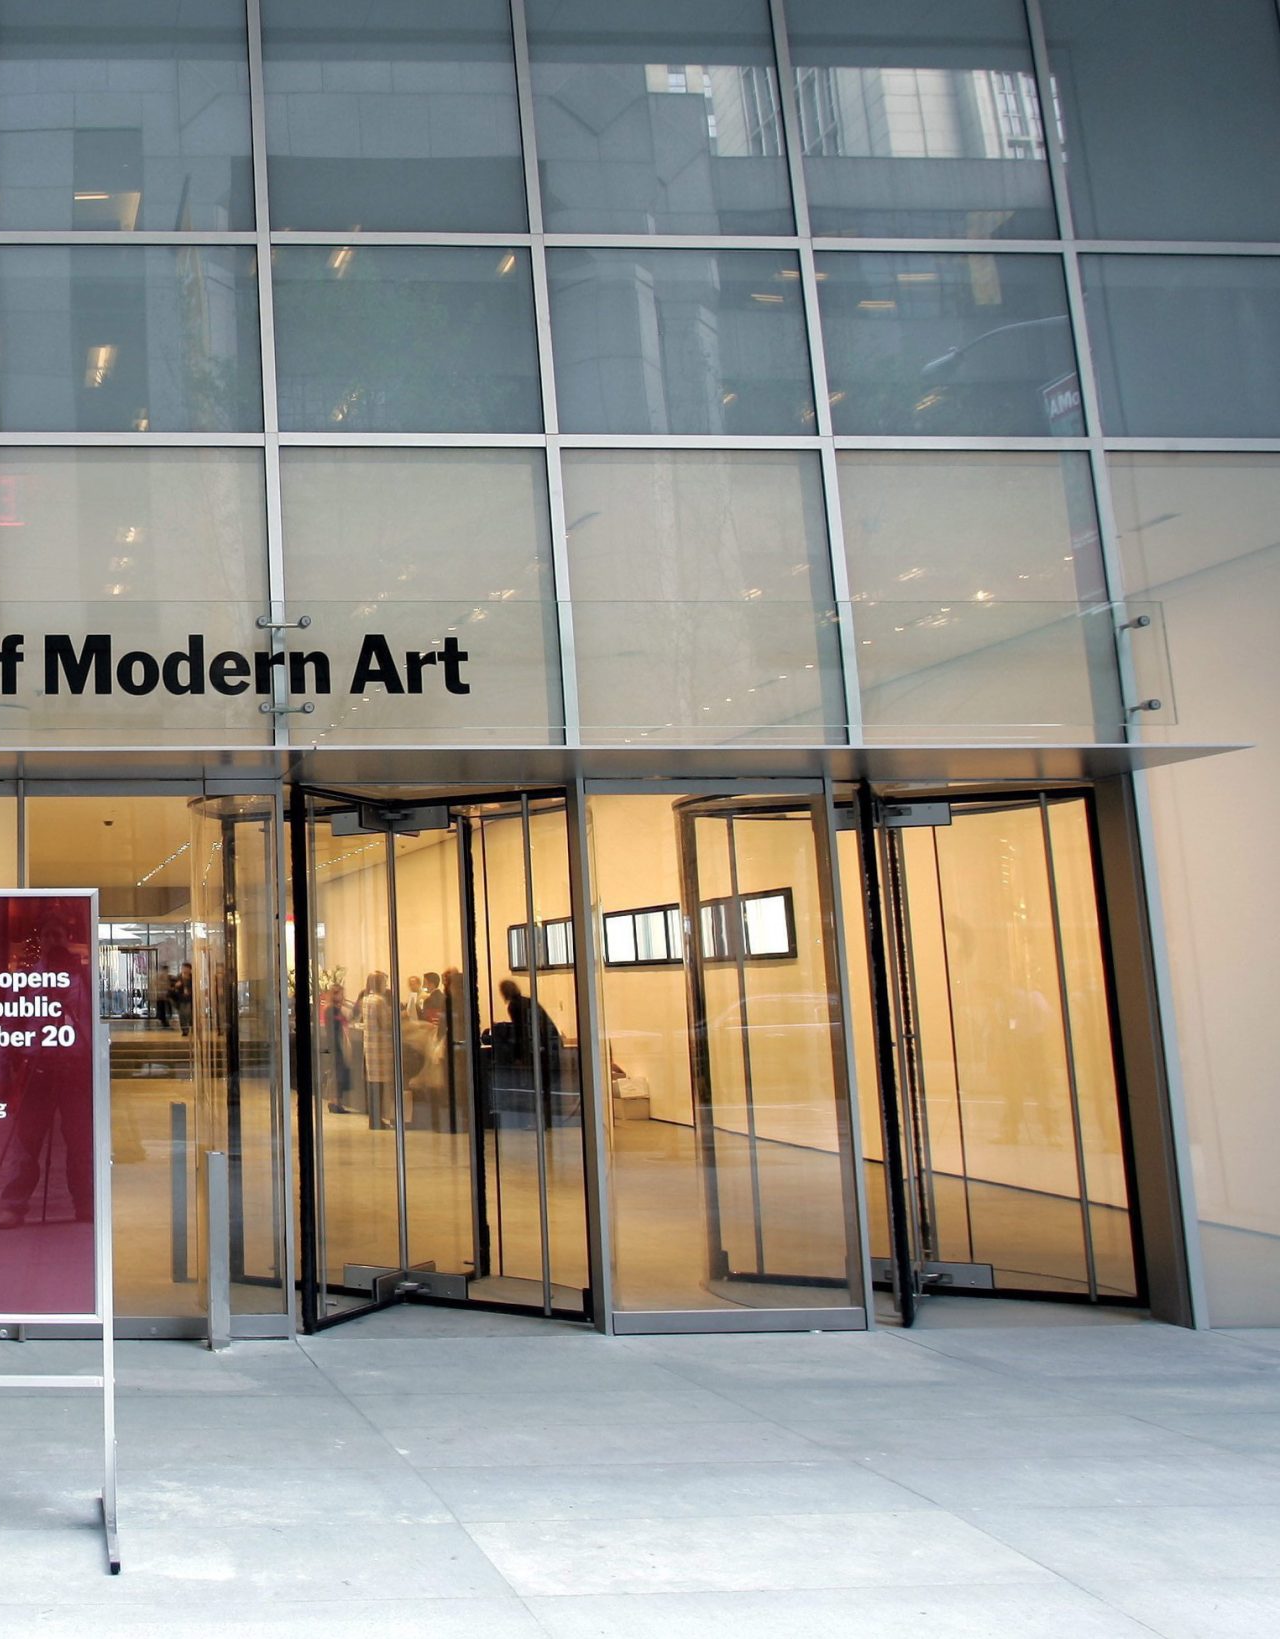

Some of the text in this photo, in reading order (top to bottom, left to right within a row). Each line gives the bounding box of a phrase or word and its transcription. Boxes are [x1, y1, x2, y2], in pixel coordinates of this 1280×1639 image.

[44, 634, 331, 696] Modern
[349, 634, 471, 695] Art
[41, 1025, 76, 1047] 20
